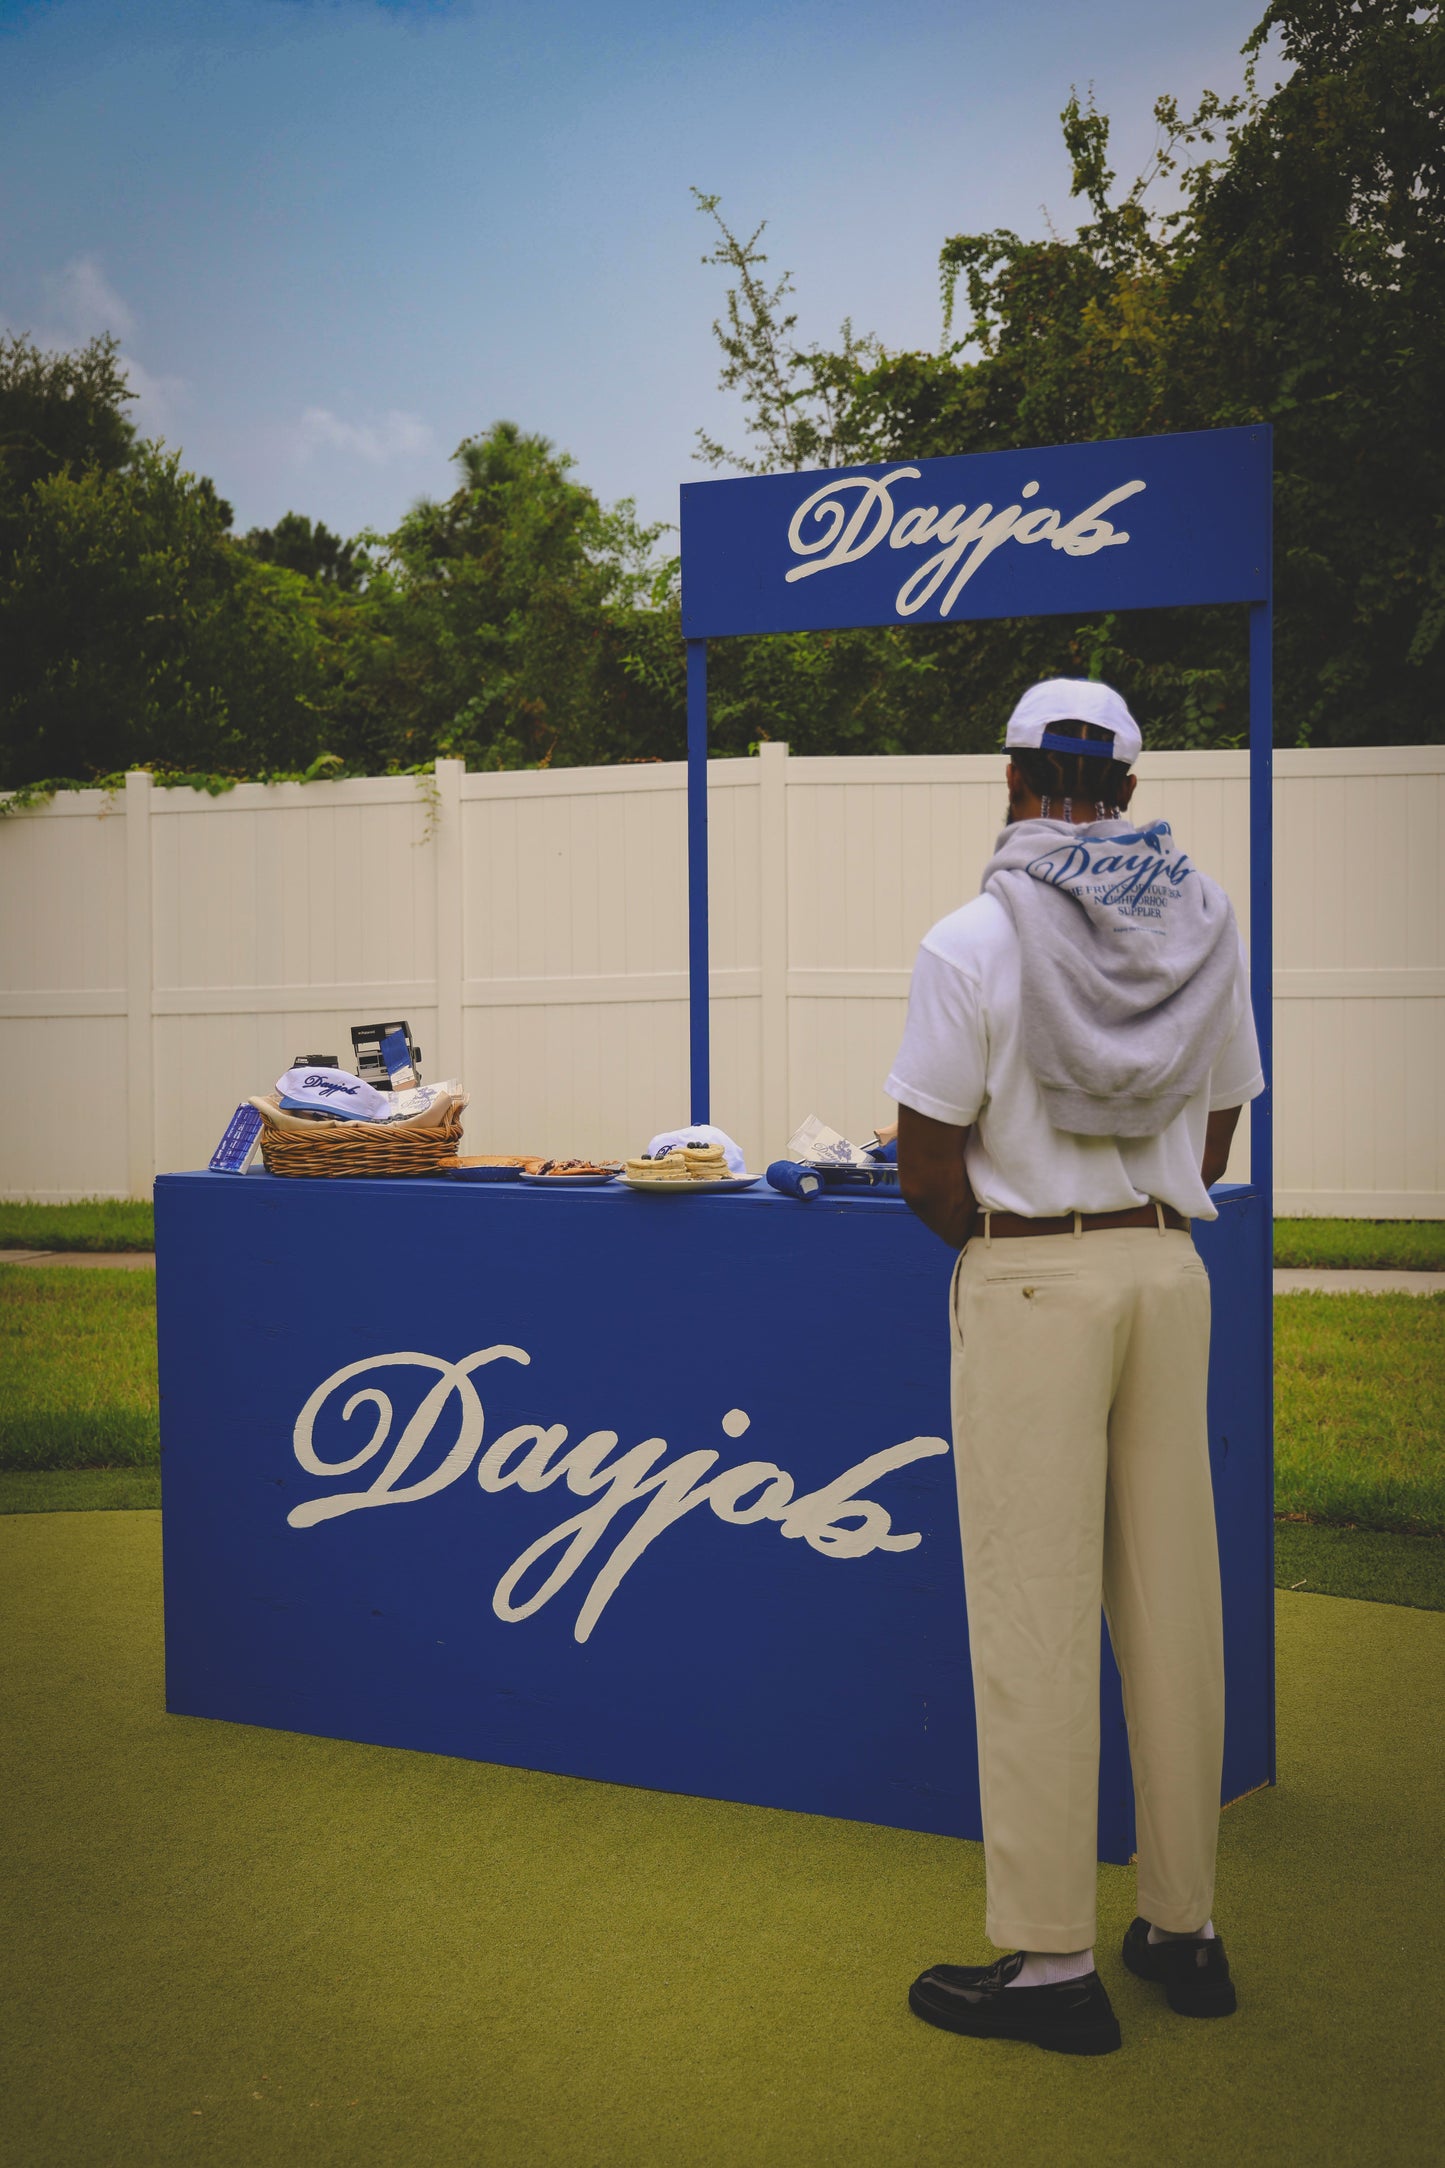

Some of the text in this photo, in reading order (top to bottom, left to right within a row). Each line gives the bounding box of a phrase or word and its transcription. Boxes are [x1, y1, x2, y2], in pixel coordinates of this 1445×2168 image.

[785, 467, 1147, 616] Dayjob
[1118, 906, 1161, 919] SUPPLIER
[302, 1075, 360, 1097] Dayjob
[287, 1345, 949, 1643] Dayjob
